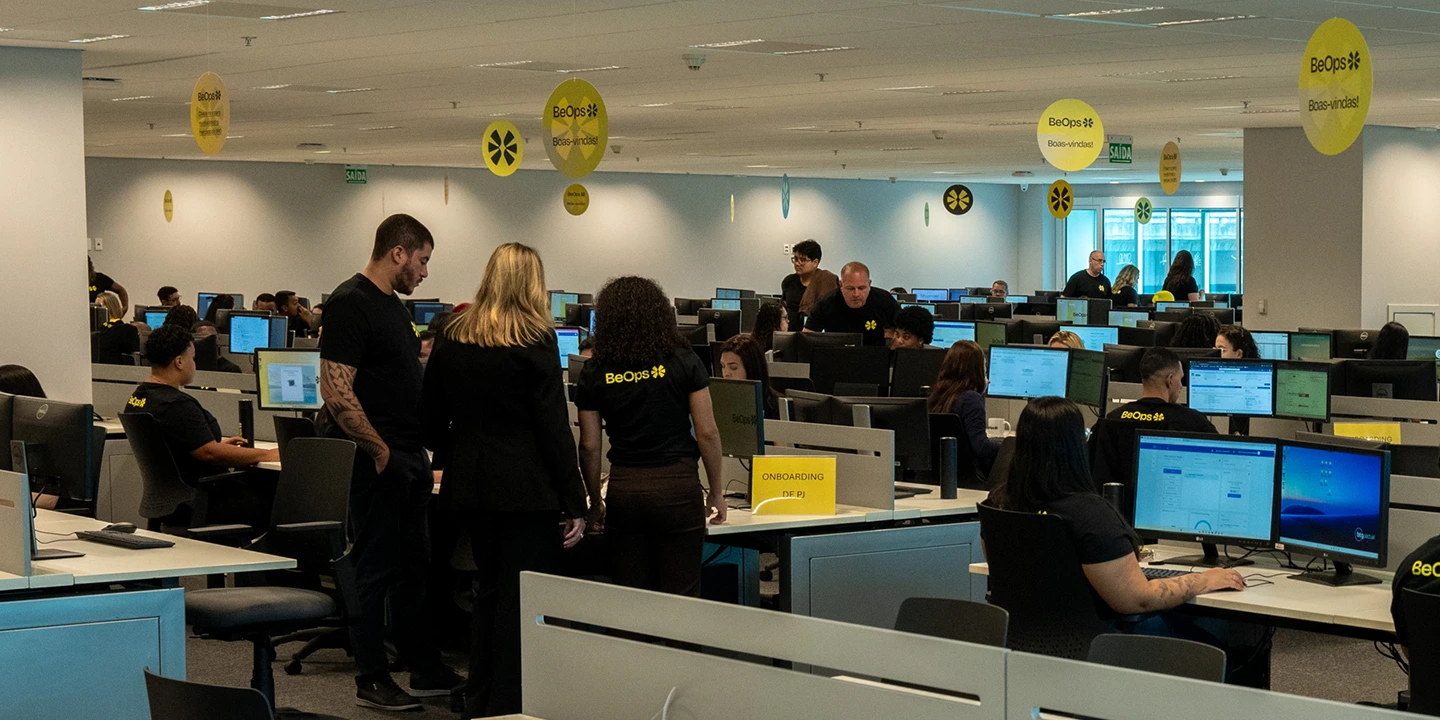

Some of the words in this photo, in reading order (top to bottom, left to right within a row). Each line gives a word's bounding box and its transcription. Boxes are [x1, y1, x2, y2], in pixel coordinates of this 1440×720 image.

[1311, 55, 1346, 74] BeOps
[198, 91, 215, 102] BeOps
[1308, 95, 1359, 112] Boas-vindas!
[553, 105, 586, 119] BeOps
[1048, 117, 1082, 128] BeOps
[553, 136, 598, 146] Boas-vindas!
[1047, 139, 1093, 149] Boas-vindas!
[1109, 143, 1132, 156] SAÍDA
[605, 370, 650, 384] BeOps
[1121, 411, 1152, 421] BeOps
[762, 473, 824, 481] ONBOARDING
[797, 491, 805, 499] PJ
